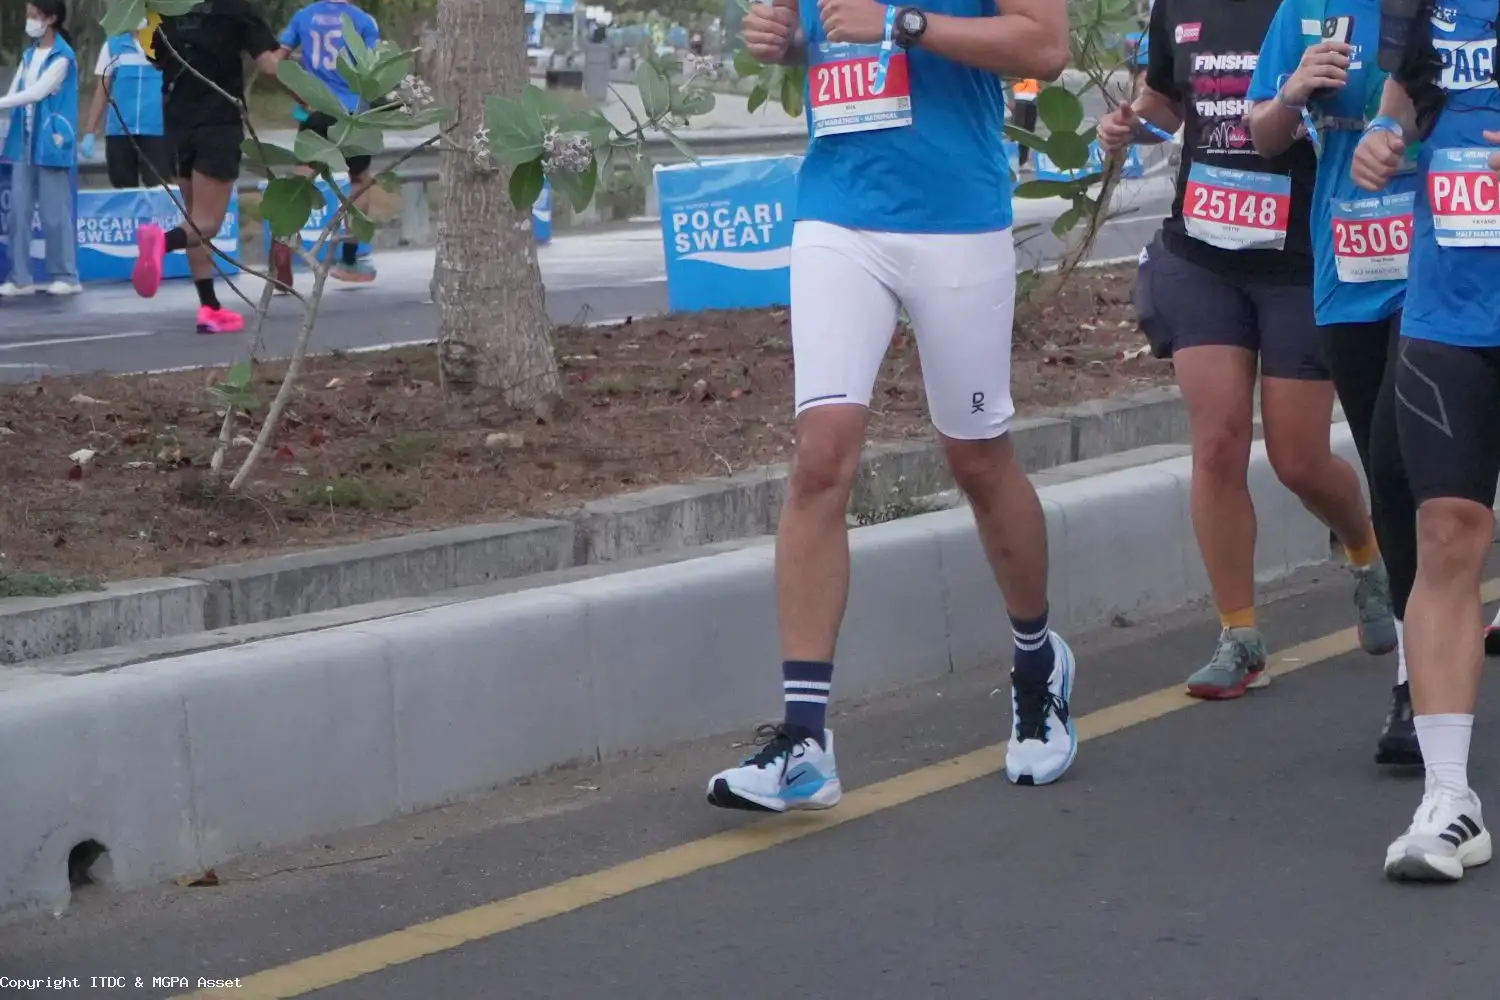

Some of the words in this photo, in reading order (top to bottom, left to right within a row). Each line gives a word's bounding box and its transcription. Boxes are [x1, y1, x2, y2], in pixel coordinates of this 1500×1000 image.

[310, 30, 342, 71] 15
[1195, 55, 1257, 70] FINISHE
[1437, 47, 1496, 82] PAC
[818, 61, 886, 102] 21115
[1196, 100, 1249, 116] FINISH
[672, 202, 783, 233] POCARI
[1193, 187, 1277, 226] 25148
[77, 229, 134, 243] SWEAT
[675, 223, 773, 253] SWEAT
[1336, 220, 1414, 254] 2506
